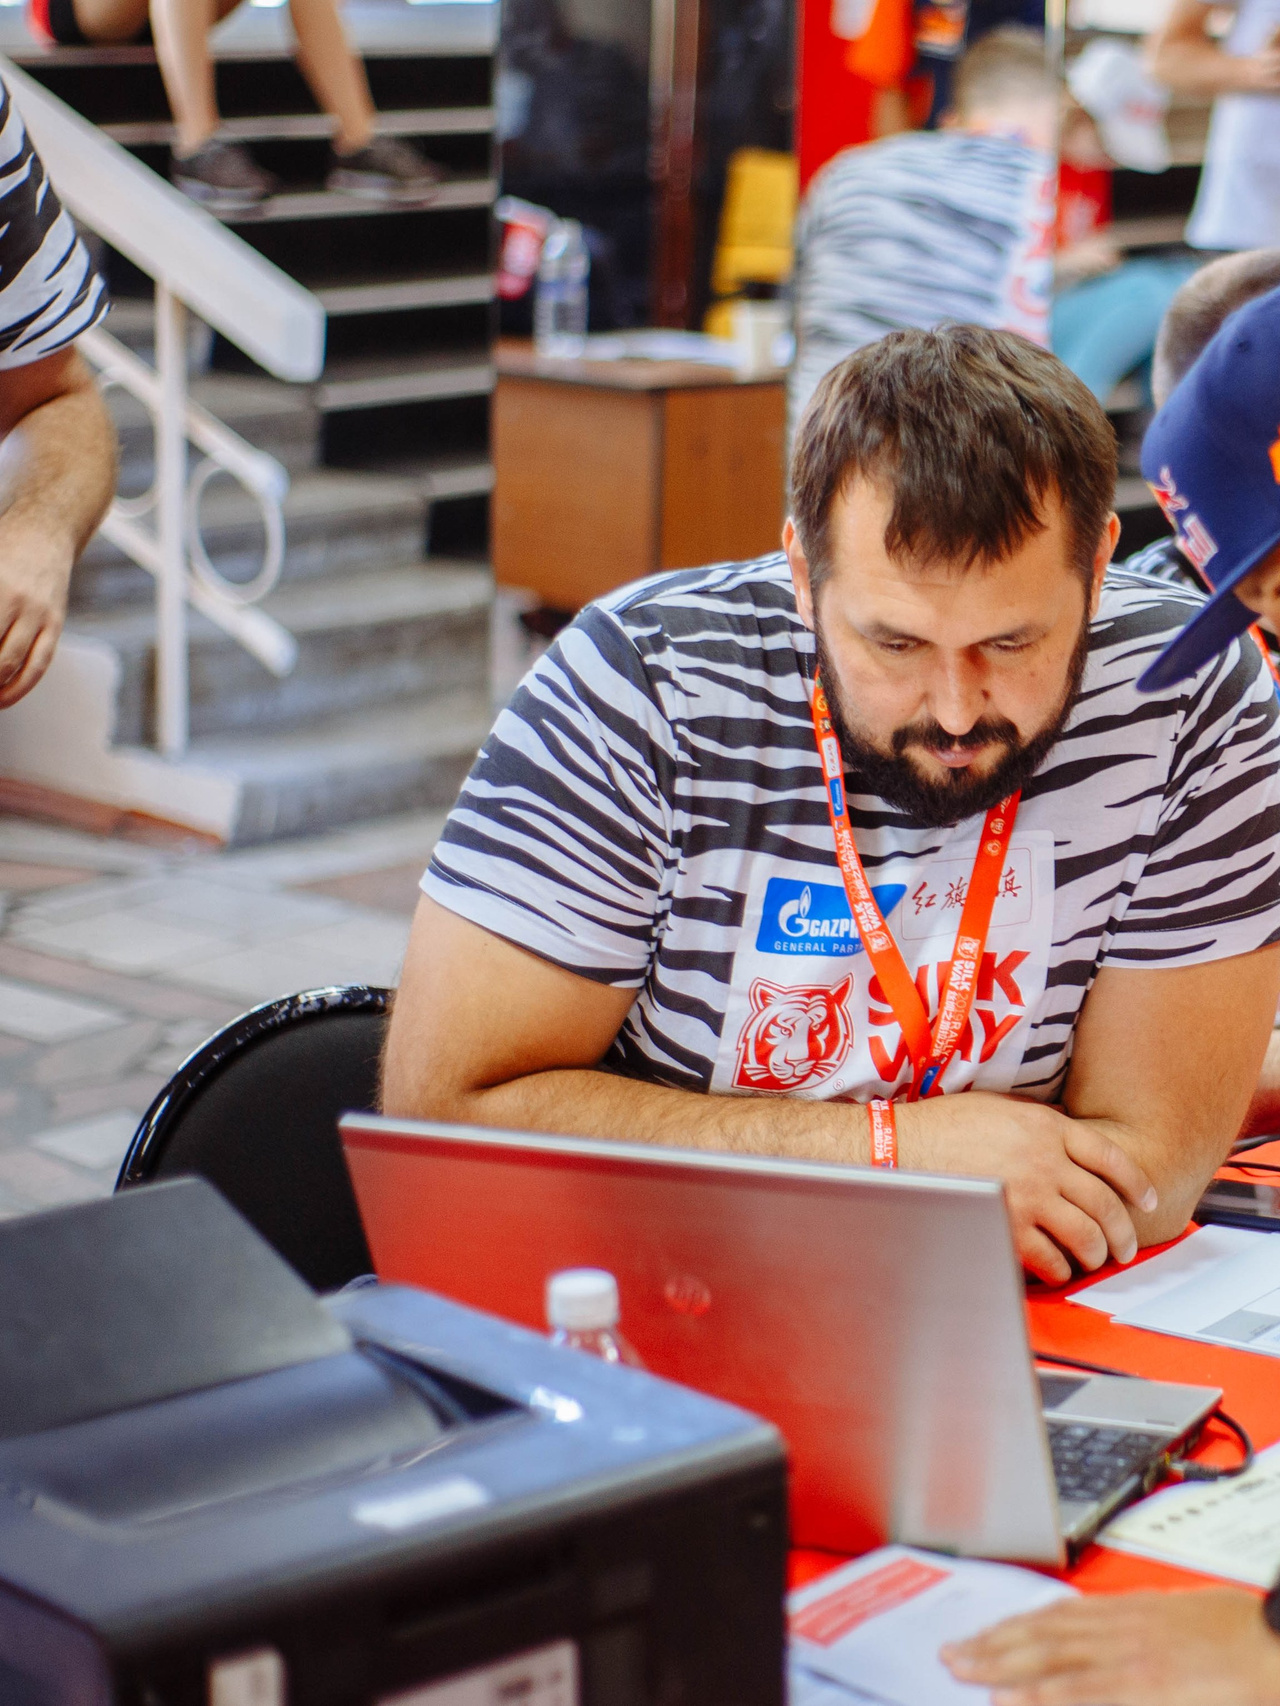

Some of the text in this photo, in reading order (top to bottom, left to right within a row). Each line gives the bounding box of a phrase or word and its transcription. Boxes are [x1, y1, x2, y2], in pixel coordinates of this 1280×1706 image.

[853, 901, 873, 933] SILK
[863, 899, 882, 929] WAY
[774, 940, 864, 953] GENERAL PART
[948, 959, 964, 989] WAY
[959, 960, 974, 991] SILK
[883, 1127, 892, 1158] RALLY
